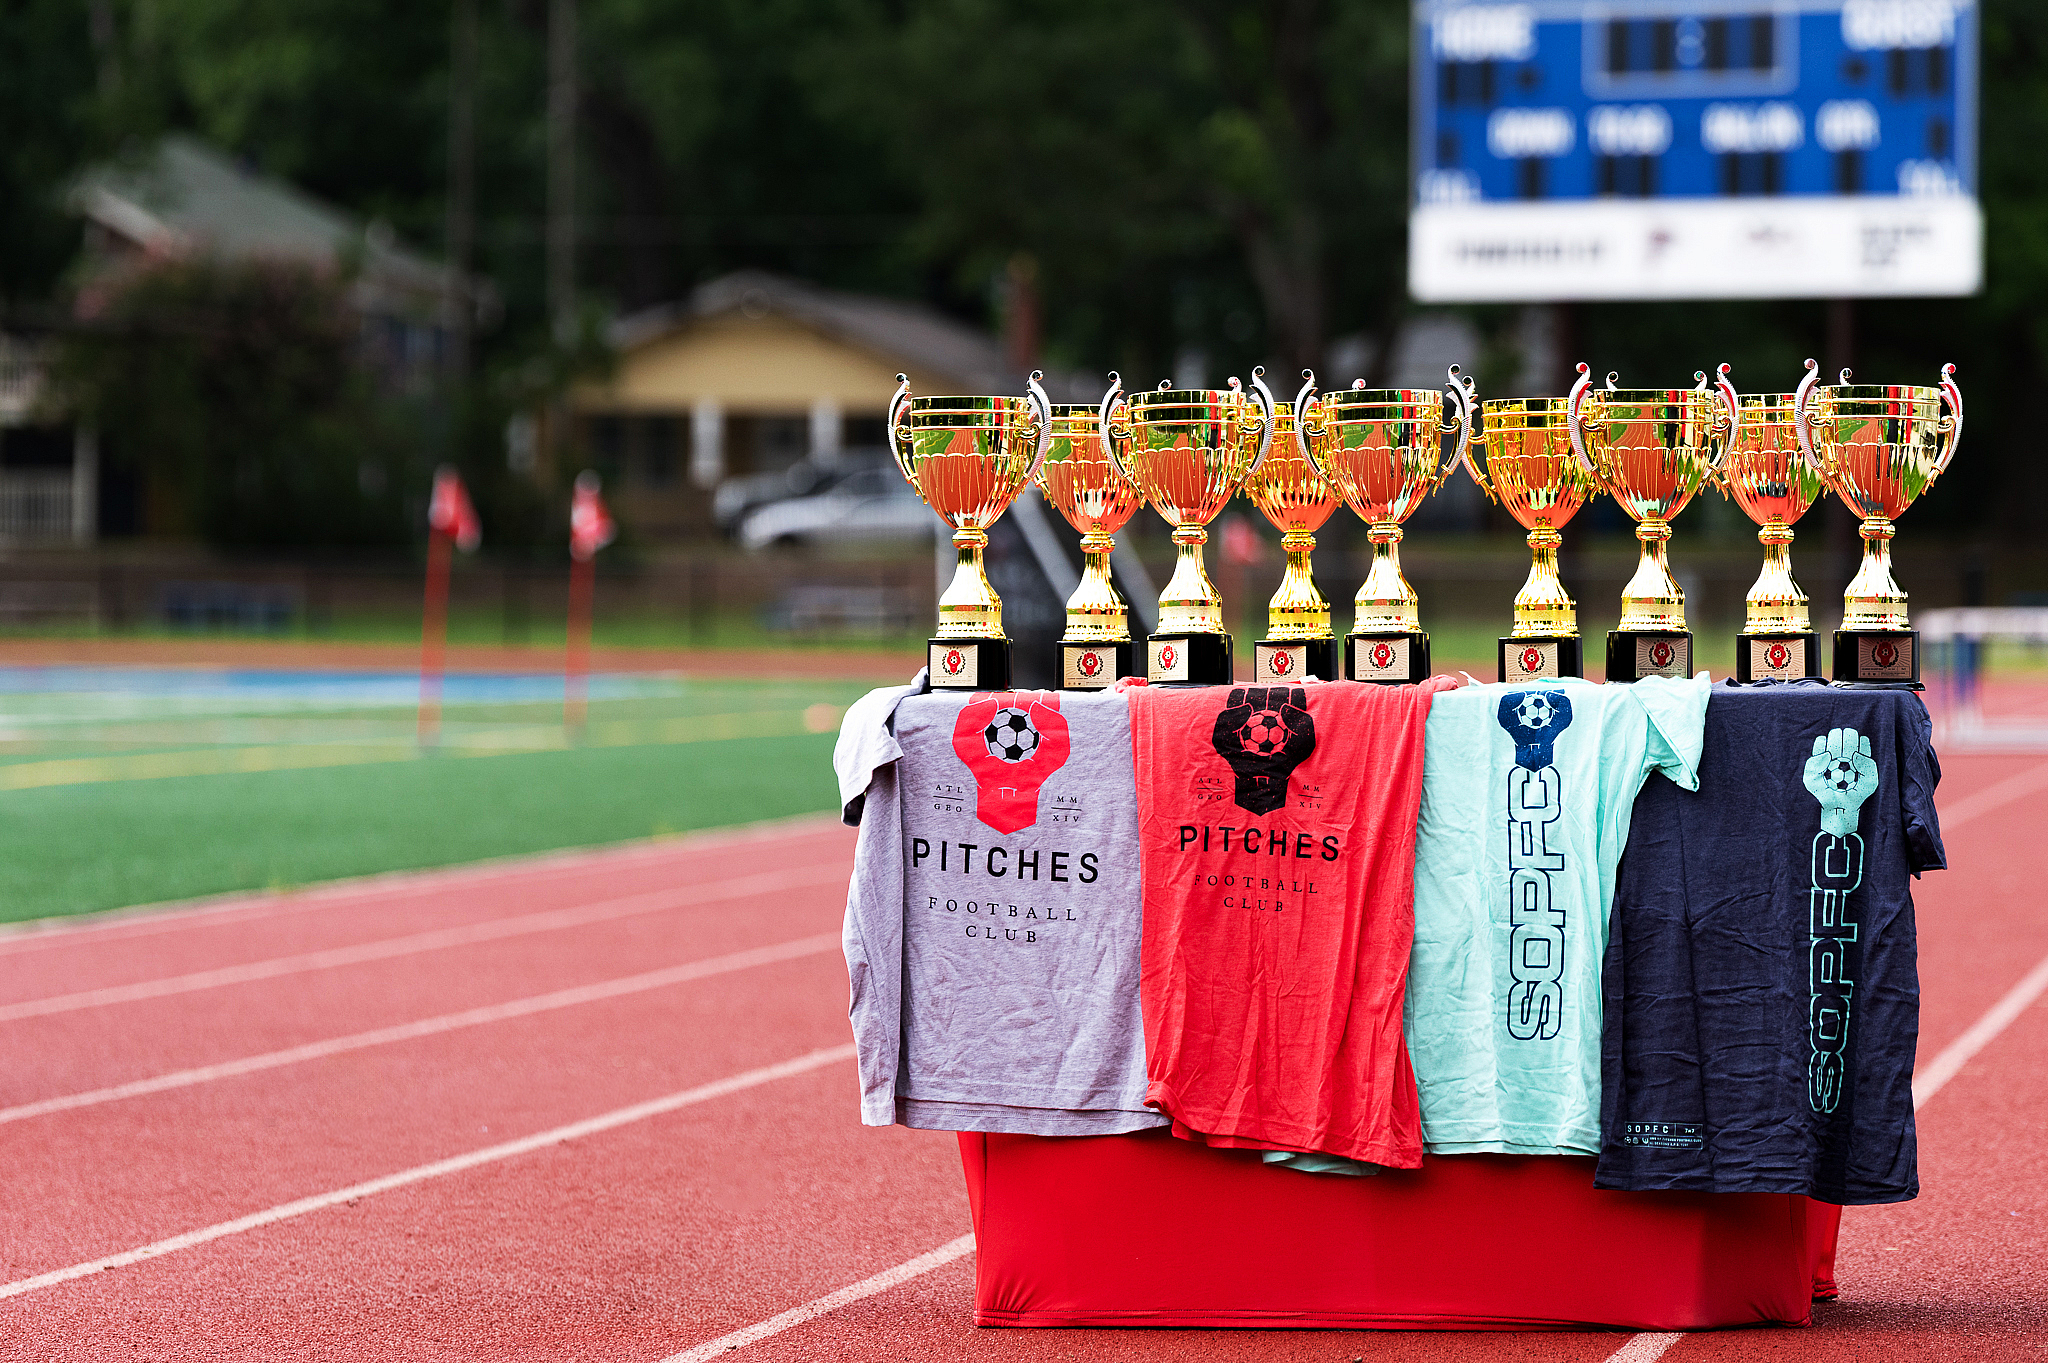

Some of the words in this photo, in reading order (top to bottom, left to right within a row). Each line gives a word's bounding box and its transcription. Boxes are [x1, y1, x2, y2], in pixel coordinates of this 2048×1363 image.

[935, 784, 963, 794] ATL
[933, 803, 963, 813] GEO
[1299, 801, 1321, 809] XIV
[1052, 814, 1080, 823] XIV
[1180, 825, 1339, 862] PITCHES
[912, 837, 1099, 884] PITCHES
[1194, 874, 1318, 894] FOOTBALL
[928, 896, 1077, 921] FOOTBALL
[1223, 896, 1283, 912] CLUB
[1507, 765, 1566, 1041] SOPFC
[965, 925, 1037, 943] CLUB
[1809, 831, 1865, 1114] SOPFC
[1627, 1124, 1669, 1134] SOPFC
